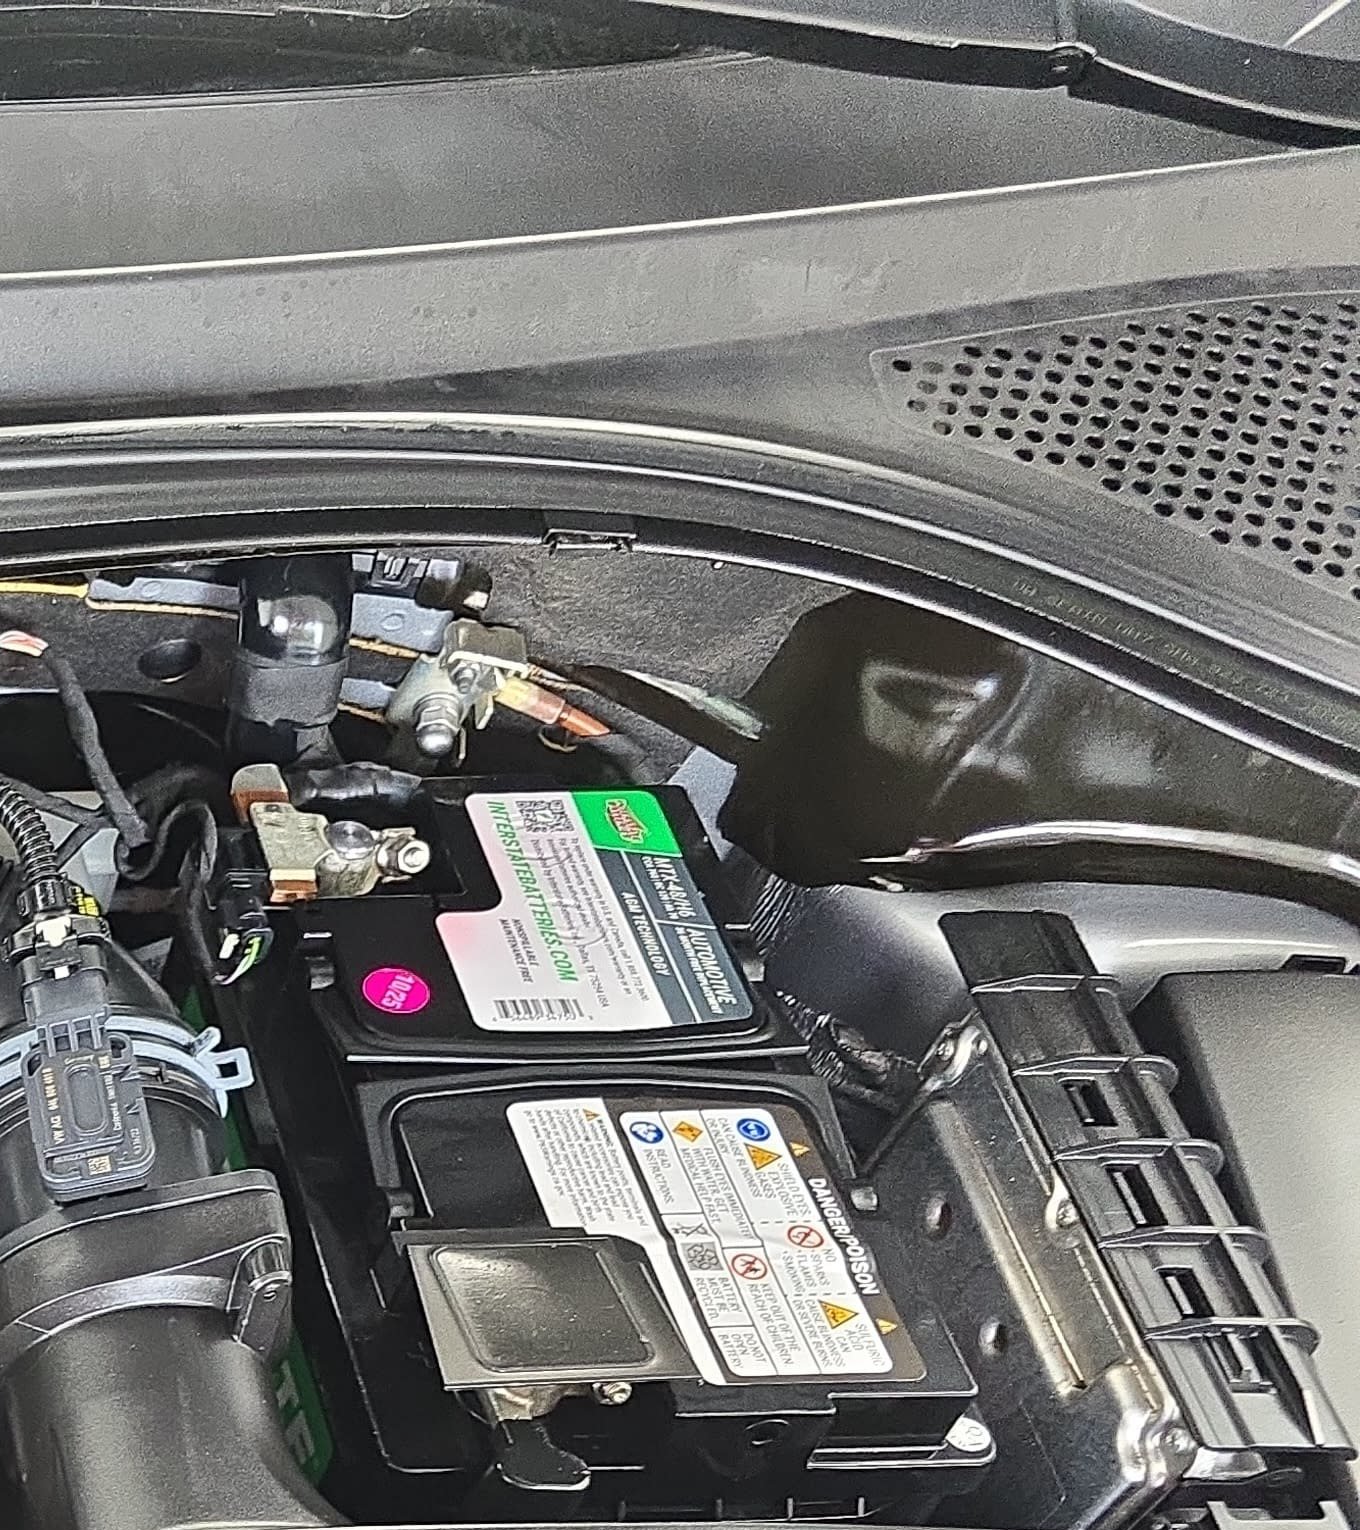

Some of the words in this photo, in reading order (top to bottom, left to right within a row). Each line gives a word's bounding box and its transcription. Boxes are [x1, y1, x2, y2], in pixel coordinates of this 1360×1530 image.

[486, 801, 579, 982] INTERSTATEBATTERIES.COM
[620, 892, 642, 913] AGM
[652, 857, 696, 917] MTX-48/H6
[498, 919, 525, 964] MAINTENANCE
[518, 966, 533, 982] FREE
[511, 918, 539, 966] NONSPILLABLE
[630, 915, 670, 975] TECHNOLOGY
[685, 928, 737, 1004] AUTOMOTIVE
[379, 973, 415, 1010] 10/25
[52, 1129, 65, 1144] VW
[704, 1118, 718, 1128] OR
[653, 1148, 673, 1168] READ
[701, 1147, 722, 1170] FLUSH
[713, 1173, 732, 1191] EYES
[716, 1117, 732, 1131] CAN
[724, 1133, 744, 1157] CAUSE
[735, 1158, 763, 1198] BLINDNESS
[679, 1148, 702, 1180] MEDICAL
[695, 1182, 712, 1201] HELP
[691, 1148, 708, 1167] WITH
[713, 1197, 730, 1212] GET
[753, 1172, 777, 1198] GASES
[776, 1163, 801, 1192] SHIELD
[765, 1171, 799, 1216] EXPLOSIVE
[805, 1178, 883, 1294] DANGER/POISON
[795, 1254, 818, 1287] FLAMES
[809, 1253, 831, 1285] SPARKS
[821, 1249, 838, 1262] NO
[781, 1255, 806, 1292] SMOKING
[705, 1277, 724, 1300] MUST
[715, 1302, 730, 1312] BE
[717, 1277, 743, 1312] BATTERY
[746, 1284, 768, 1310] REACH
[760, 1312, 774, 1324] OF
[758, 1283, 777, 1303] KEEP
[790, 1299, 806, 1310] OR
[769, 1305, 786, 1320] OUT
[777, 1323, 792, 1333] OF
[796, 1311, 820, 1338] SEVERE
[729, 1333, 750, 1355] OPEN
[742, 1333, 758, 1345] DO
[783, 1335, 801, 1351] THE
[803, 1299, 825, 1323] CAUSE
[816, 1325, 847, 1366] BLINDNESS
[834, 1336, 853, 1353] CAN
[844, 1329, 865, 1350] ACID
[855, 1323, 886, 1366] SULFURIC
[748, 1346, 766, 1362] NOT
